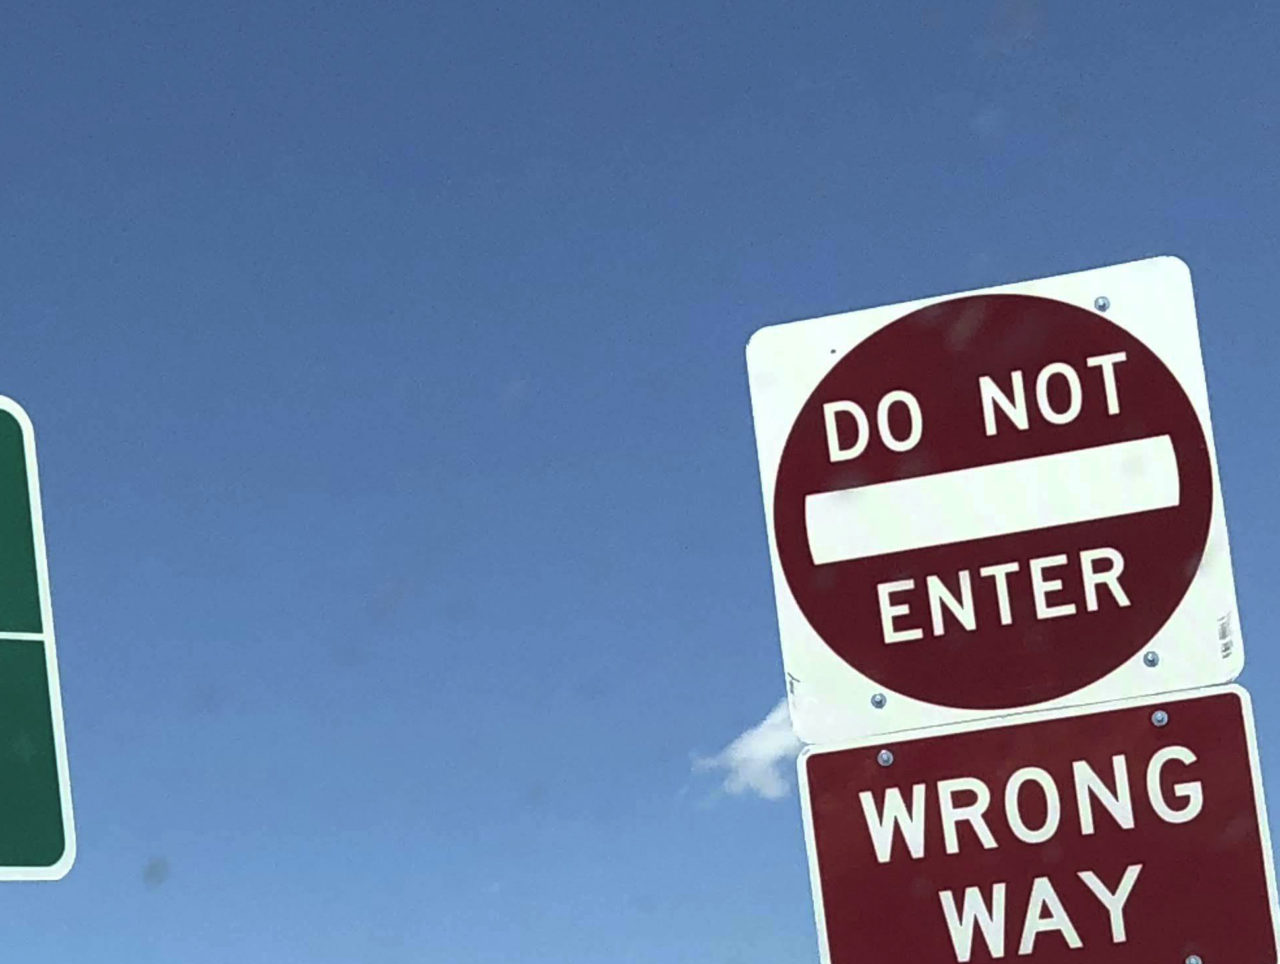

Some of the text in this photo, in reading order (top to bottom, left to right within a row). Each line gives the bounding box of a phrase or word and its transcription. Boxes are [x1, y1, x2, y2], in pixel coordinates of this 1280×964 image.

[823, 351, 1127, 463] DO NOT
[877, 547, 1131, 644] ENTER
[858, 745, 1204, 863] WRONG
[938, 864, 1143, 963] WAY
